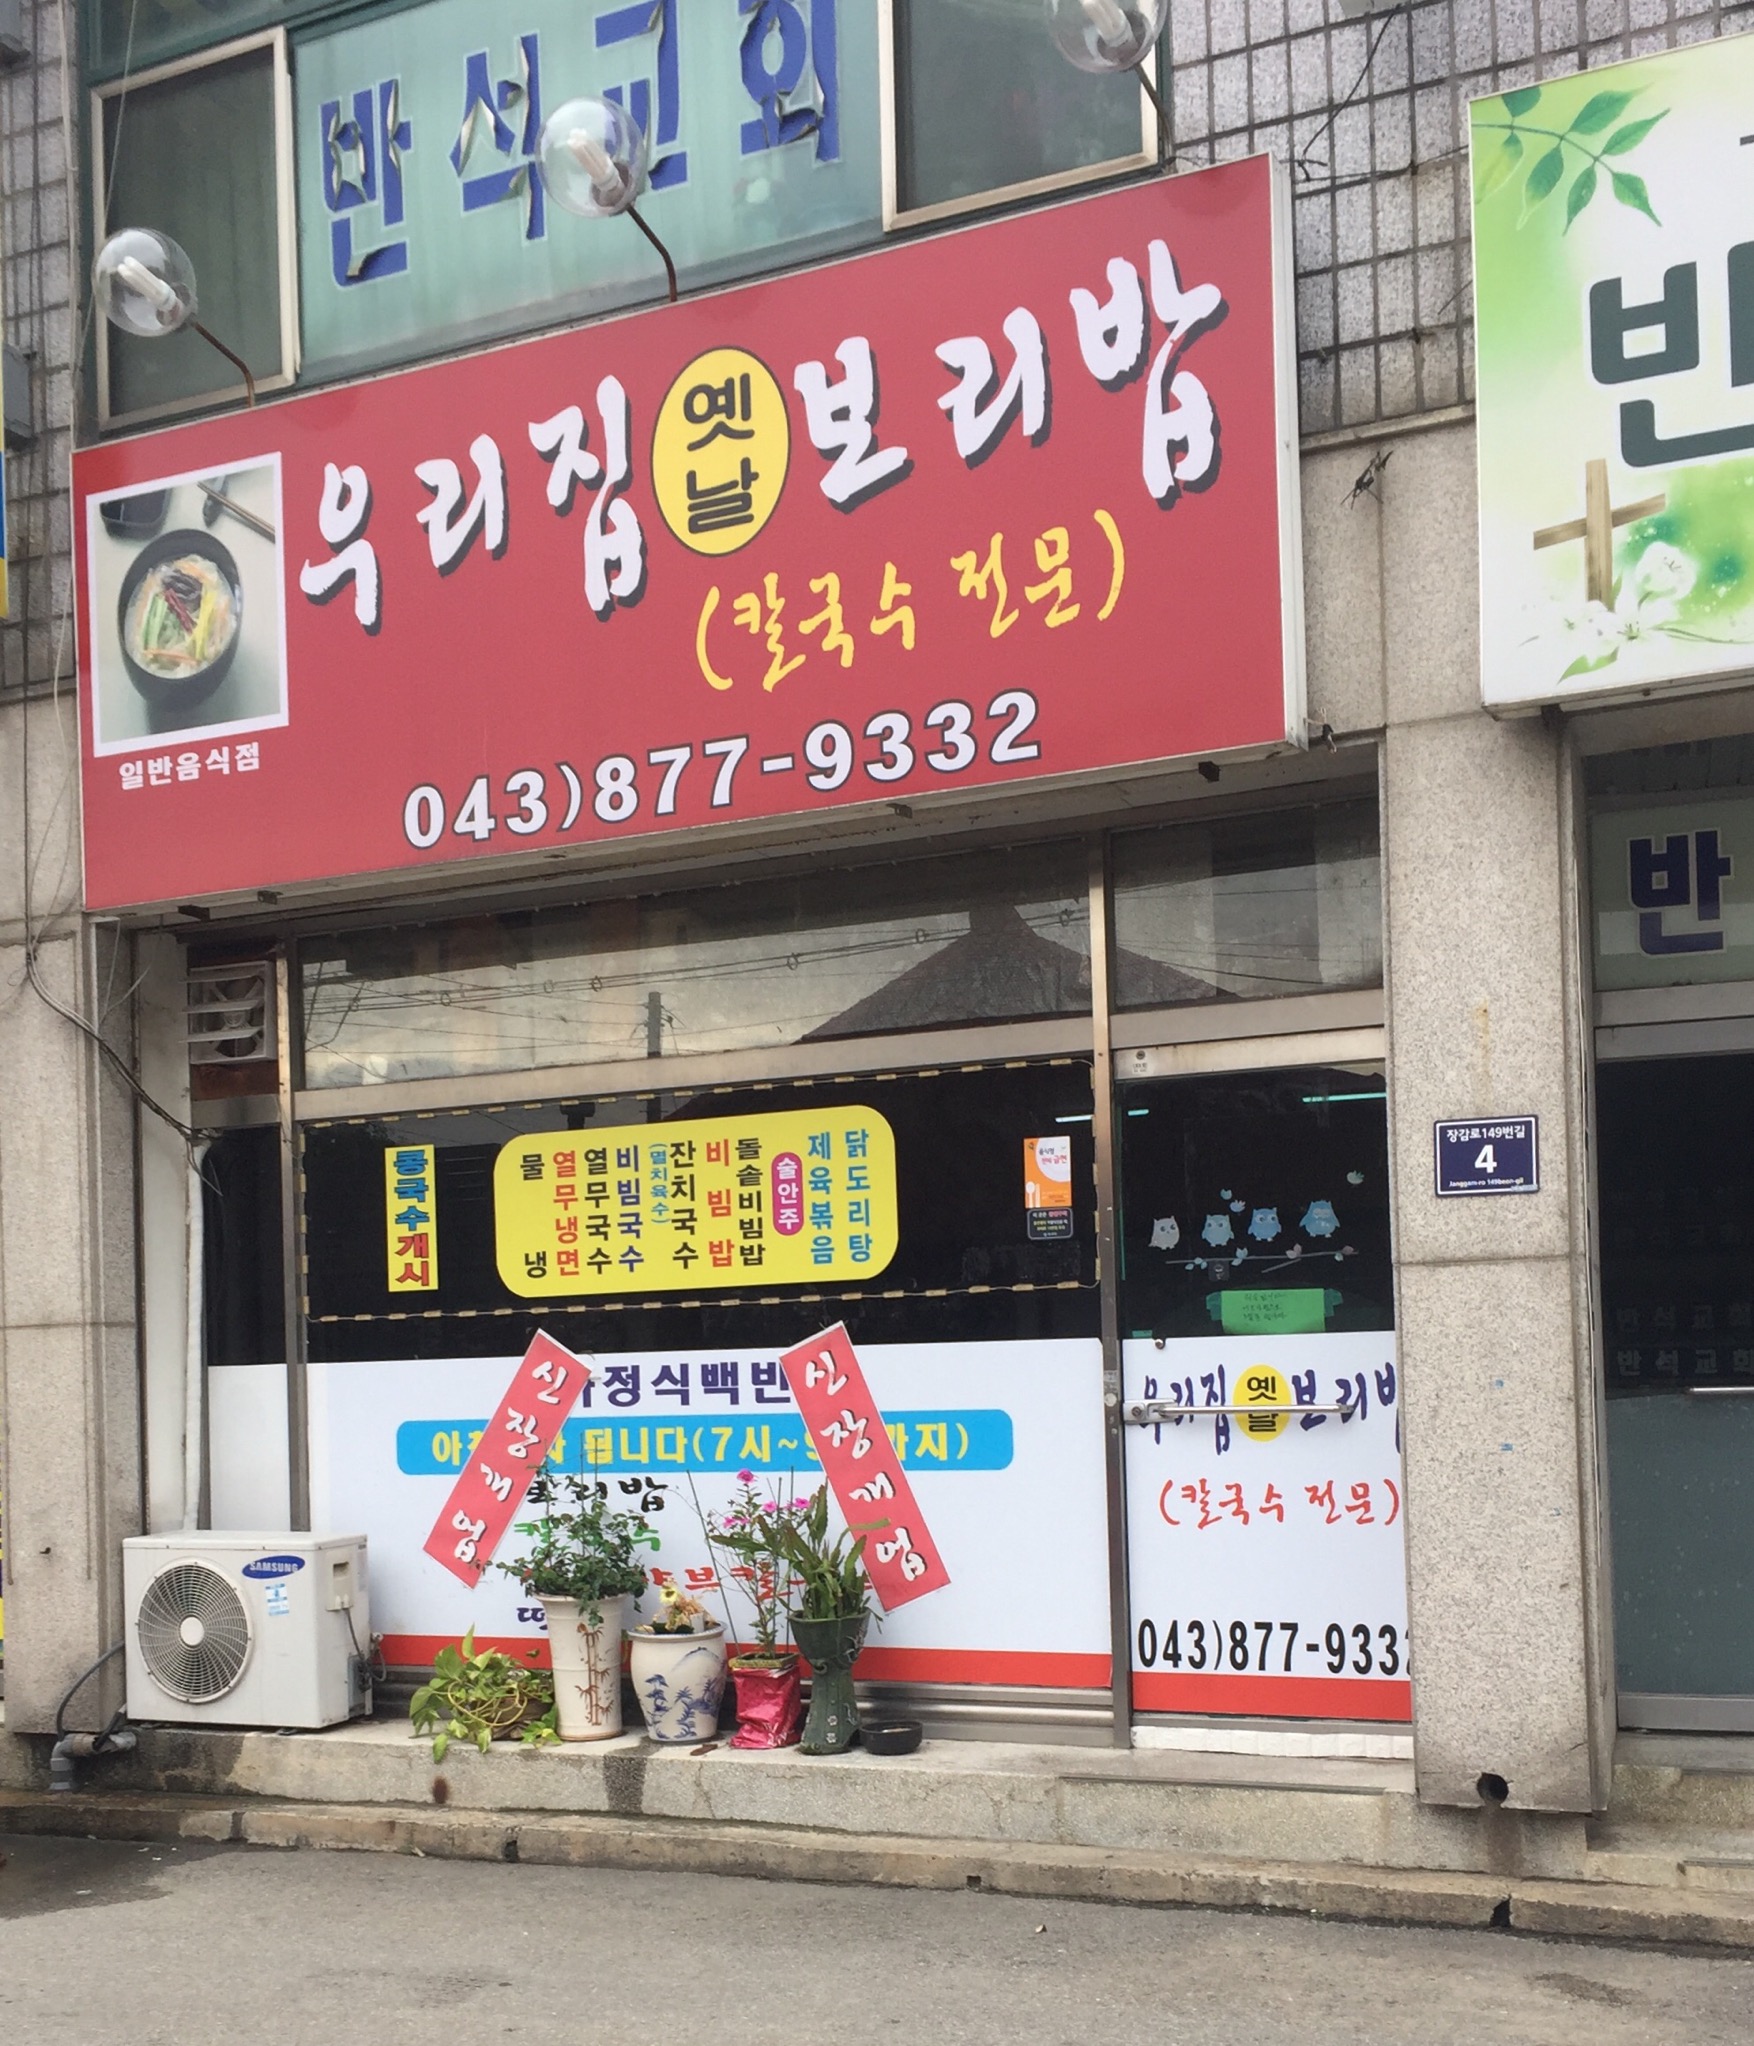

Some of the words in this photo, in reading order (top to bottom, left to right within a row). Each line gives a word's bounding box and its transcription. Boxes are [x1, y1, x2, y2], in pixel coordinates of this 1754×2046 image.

[320, 0, 839, 287] 반석교회
[300, 374, 647, 636] 우리집
[683, 372, 759, 534] 옛날
[794, 239, 1229, 510] 보리밥
[696, 561, 915, 692] (칼국수
[951, 509, 1125, 638] 전문)
[118, 742, 261, 790] 일반음식점
[403, 688, 1041, 850] 043)877-9332
[1629, 830, 1732, 955] 반
[776, 1157, 800, 1231] 술안주
[808, 1131, 835, 1265] 제육볶음
[844, 1128, 873, 1263] 닭도리탕
[1446, 1124, 1526, 1143] 장감로149번길
[1474, 1144, 1498, 1174] 4
[552, 1150, 580, 1277] 열무냉면
[584, 1147, 613, 1275] 열무국수
[616, 1145, 644, 1273] 비빔국수
[669, 1140, 699, 1270] 잔치국수
[706, 1138, 735, 1268] 비빔밥
[735, 1137, 766, 1267] 돌솥비빔밥
[451, 1360, 568, 1564] 신장개업
[805, 1350, 928, 1582] 신장개업
[1159, 1478, 1285, 1529] (칼국수
[1304, 1478, 1400, 1527] 전문)
[249, 1560, 299, 1573] SAMSUNG
[1138, 1618, 1411, 1677] 043)877-933
